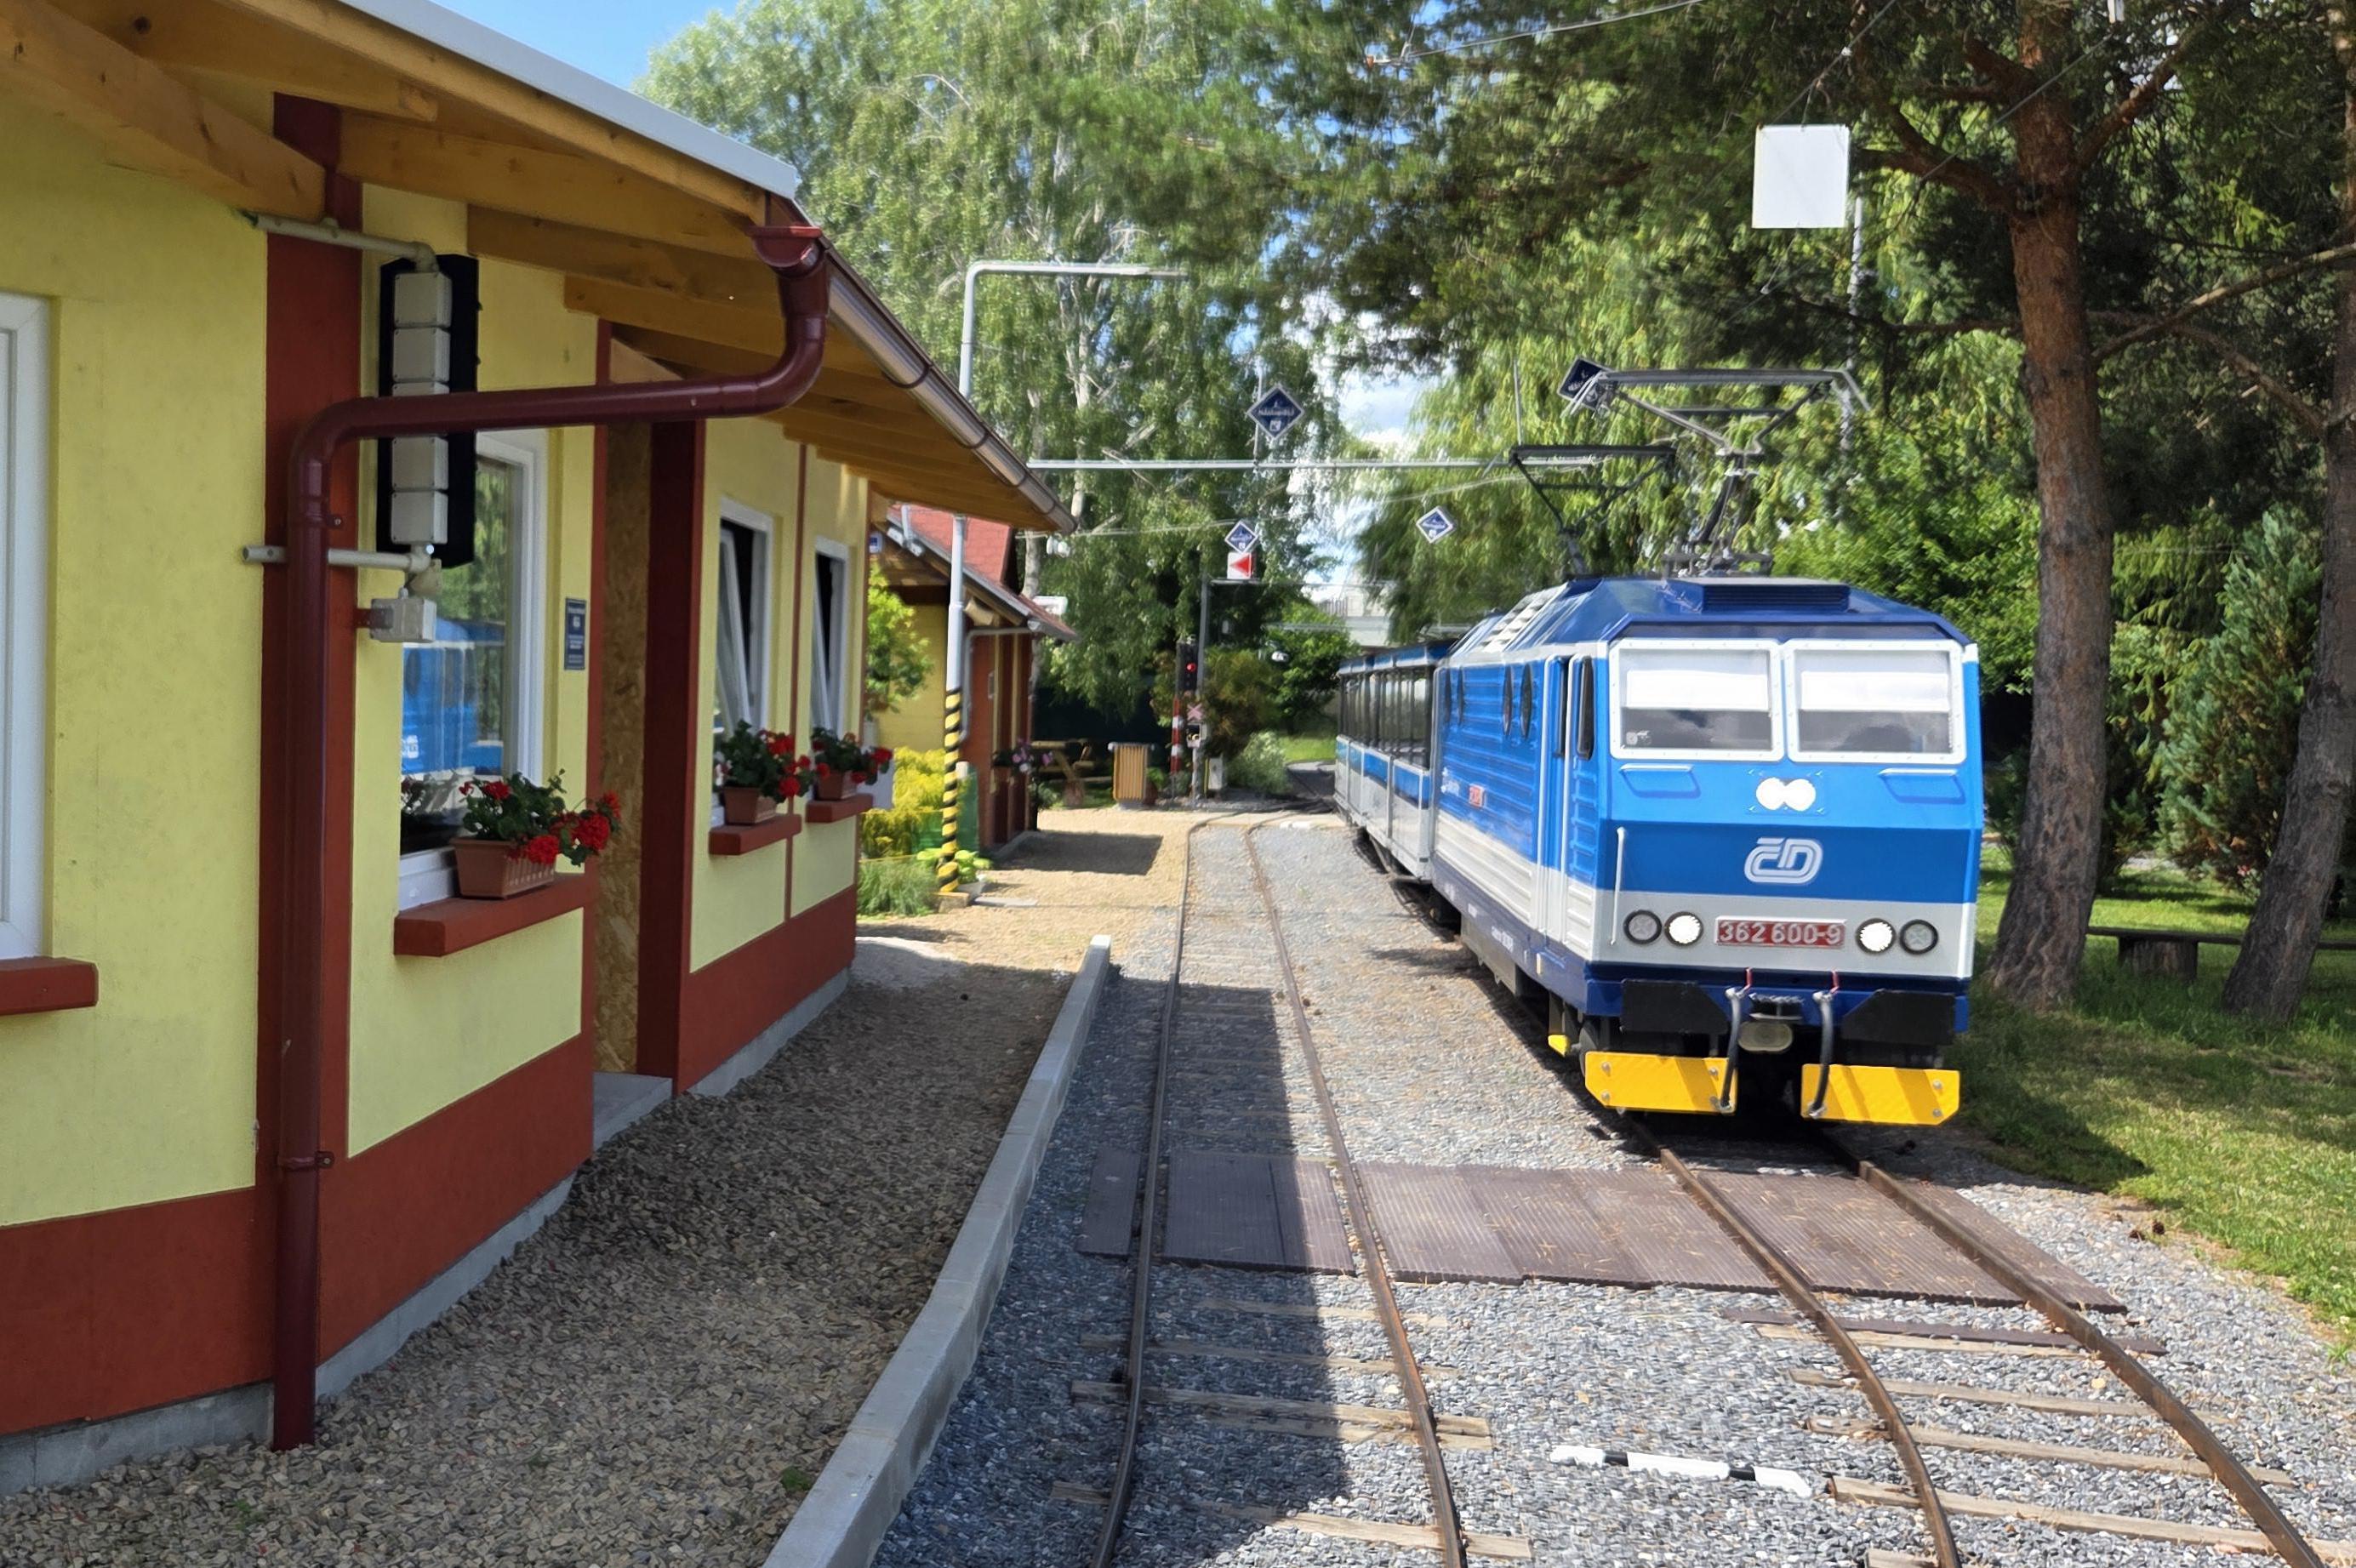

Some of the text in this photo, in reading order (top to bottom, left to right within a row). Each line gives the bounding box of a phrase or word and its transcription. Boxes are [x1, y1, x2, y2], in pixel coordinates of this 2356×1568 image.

[1743, 837, 1823, 884] ČD
[1720, 921, 1841, 944] 362 600-9
